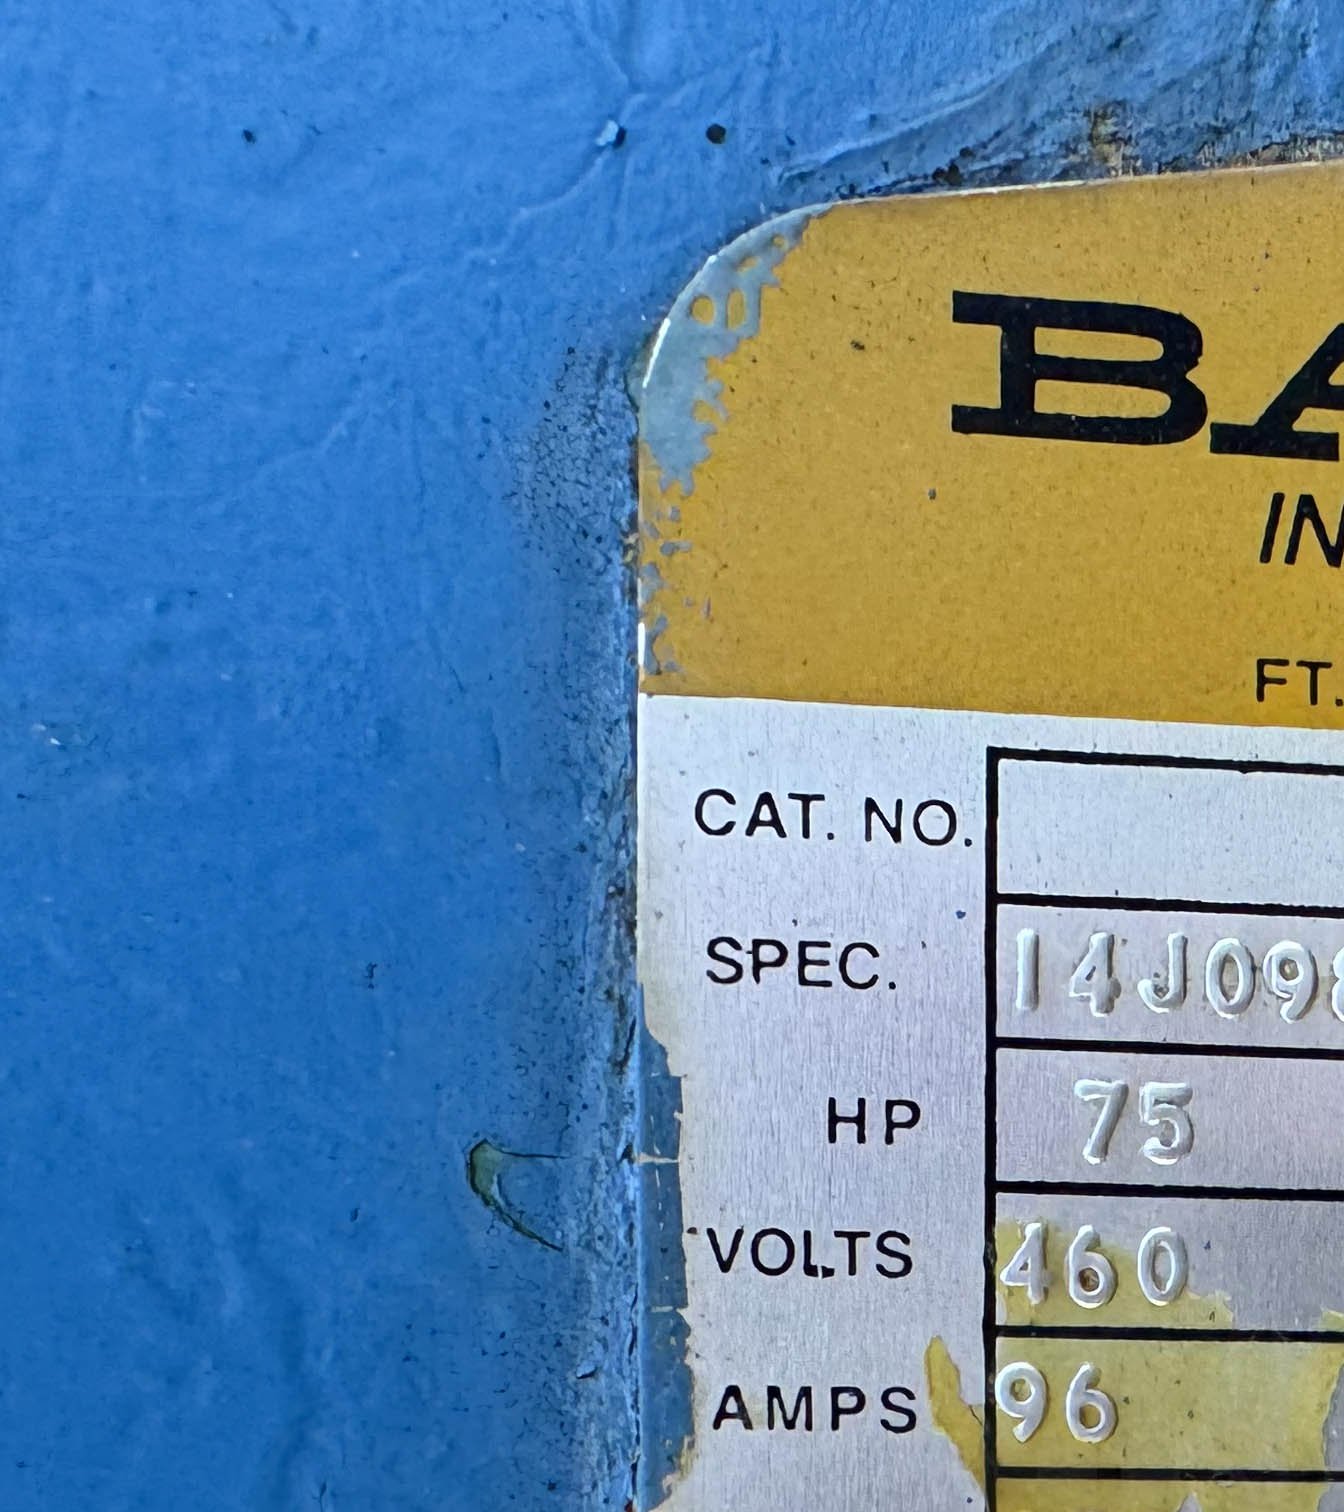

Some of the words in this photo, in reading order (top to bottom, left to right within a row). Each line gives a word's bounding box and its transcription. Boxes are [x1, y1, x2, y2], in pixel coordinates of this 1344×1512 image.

[1255, 659, 1344, 708] FT.
[693, 789, 835, 841] CAT.
[863, 798, 973, 848] NO.
[705, 936, 897, 991] SPEC.
[827, 1098, 922, 1146] HP
[1072, 1079, 1195, 1165] 75
[705, 1227, 913, 1280] VOLTS
[999, 1221, 1188, 1303] 460
[712, 1386, 918, 1434] AMPS
[996, 1360, 1118, 1443] 96
